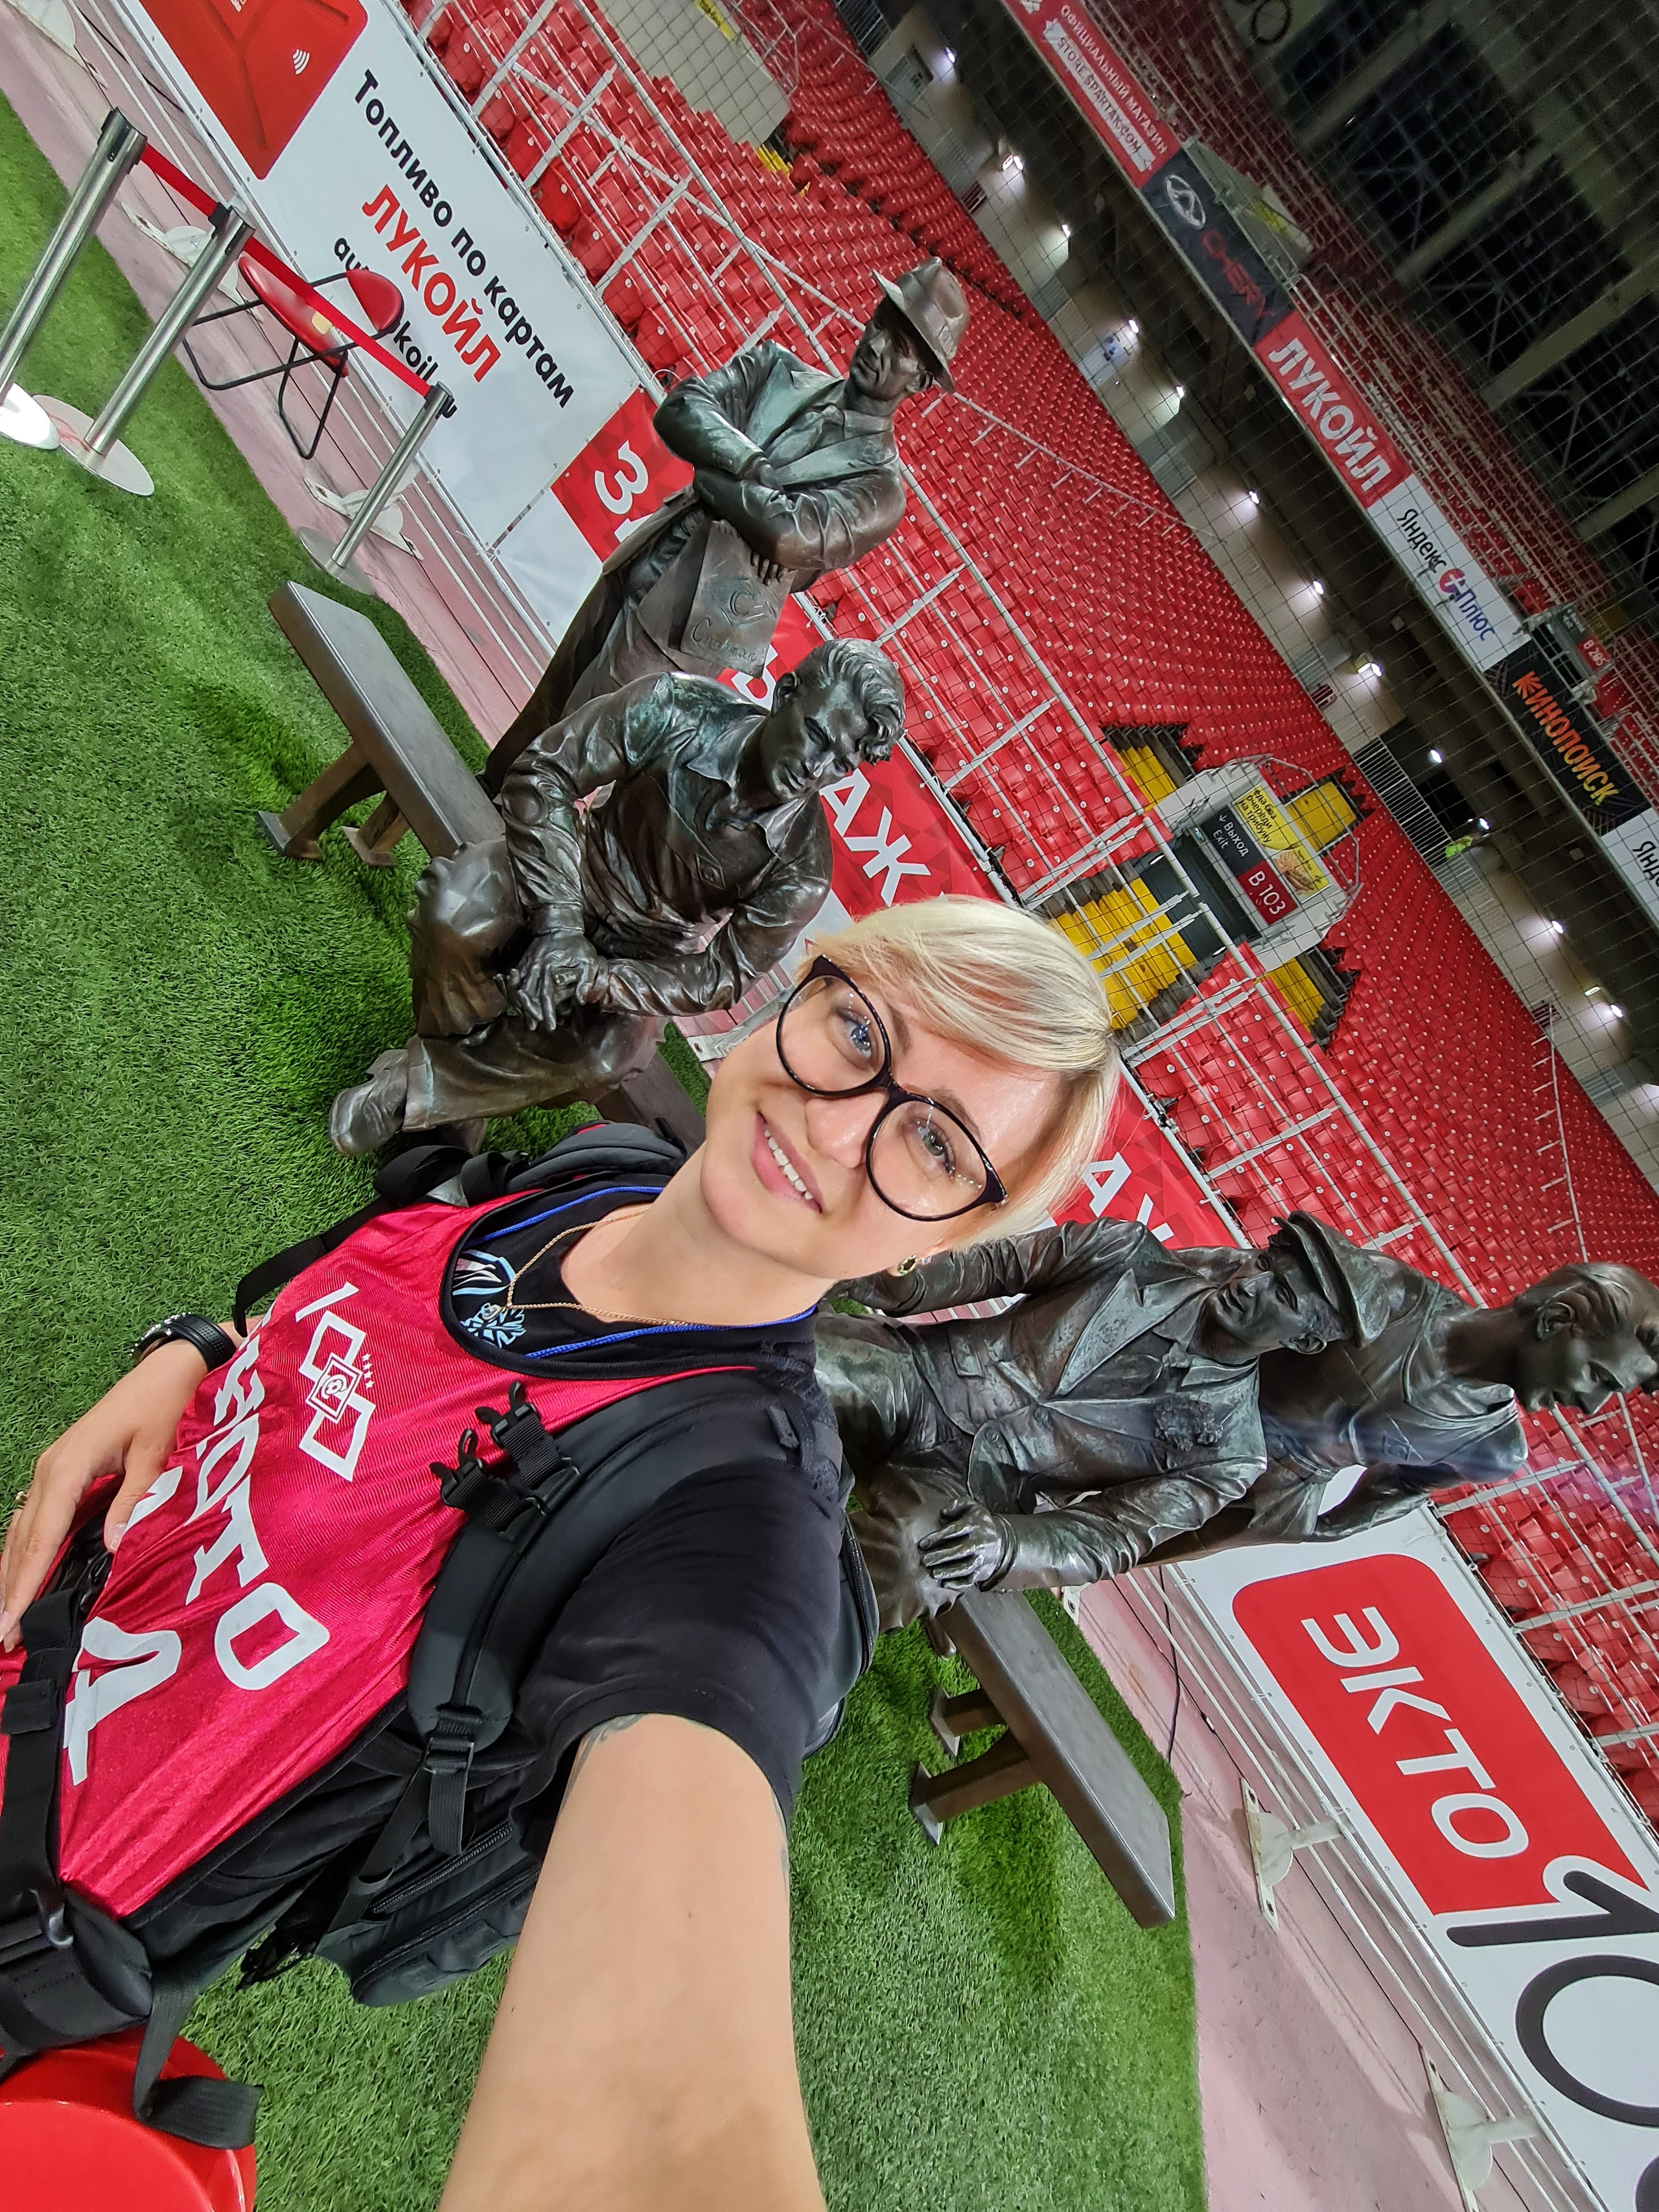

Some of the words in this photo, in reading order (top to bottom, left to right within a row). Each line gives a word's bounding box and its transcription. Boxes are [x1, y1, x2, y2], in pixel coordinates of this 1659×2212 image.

[1061, 5, 1131, 100] ОФИЦИАЛЬНЫЙ
[1126, 97, 1168, 155] МАГАЗИН
[354, 69, 453, 227] Топливо
[451, 227, 486, 277] по
[483, 275, 574, 408] картам
[362, 184, 502, 383] ЛУКОЙЛ
[1268, 338, 1391, 492] ЛУКОЙЛ
[1397, 508, 1446, 574] Яндекс
[1455, 589, 1496, 642] Плюс
[1588, 647, 1610, 666] 205
[1246, 795, 1273, 830] очереди
[1253, 789, 1268, 808] еда
[1212, 830, 1229, 850] Exit
[1224, 821, 1249, 857] Выход
[1239, 799, 1248, 811] на
[1246, 810, 1272, 843] трибуну
[1259, 883, 1286, 914] 103
[1300, 1606, 1529, 1859] ЭКТО
